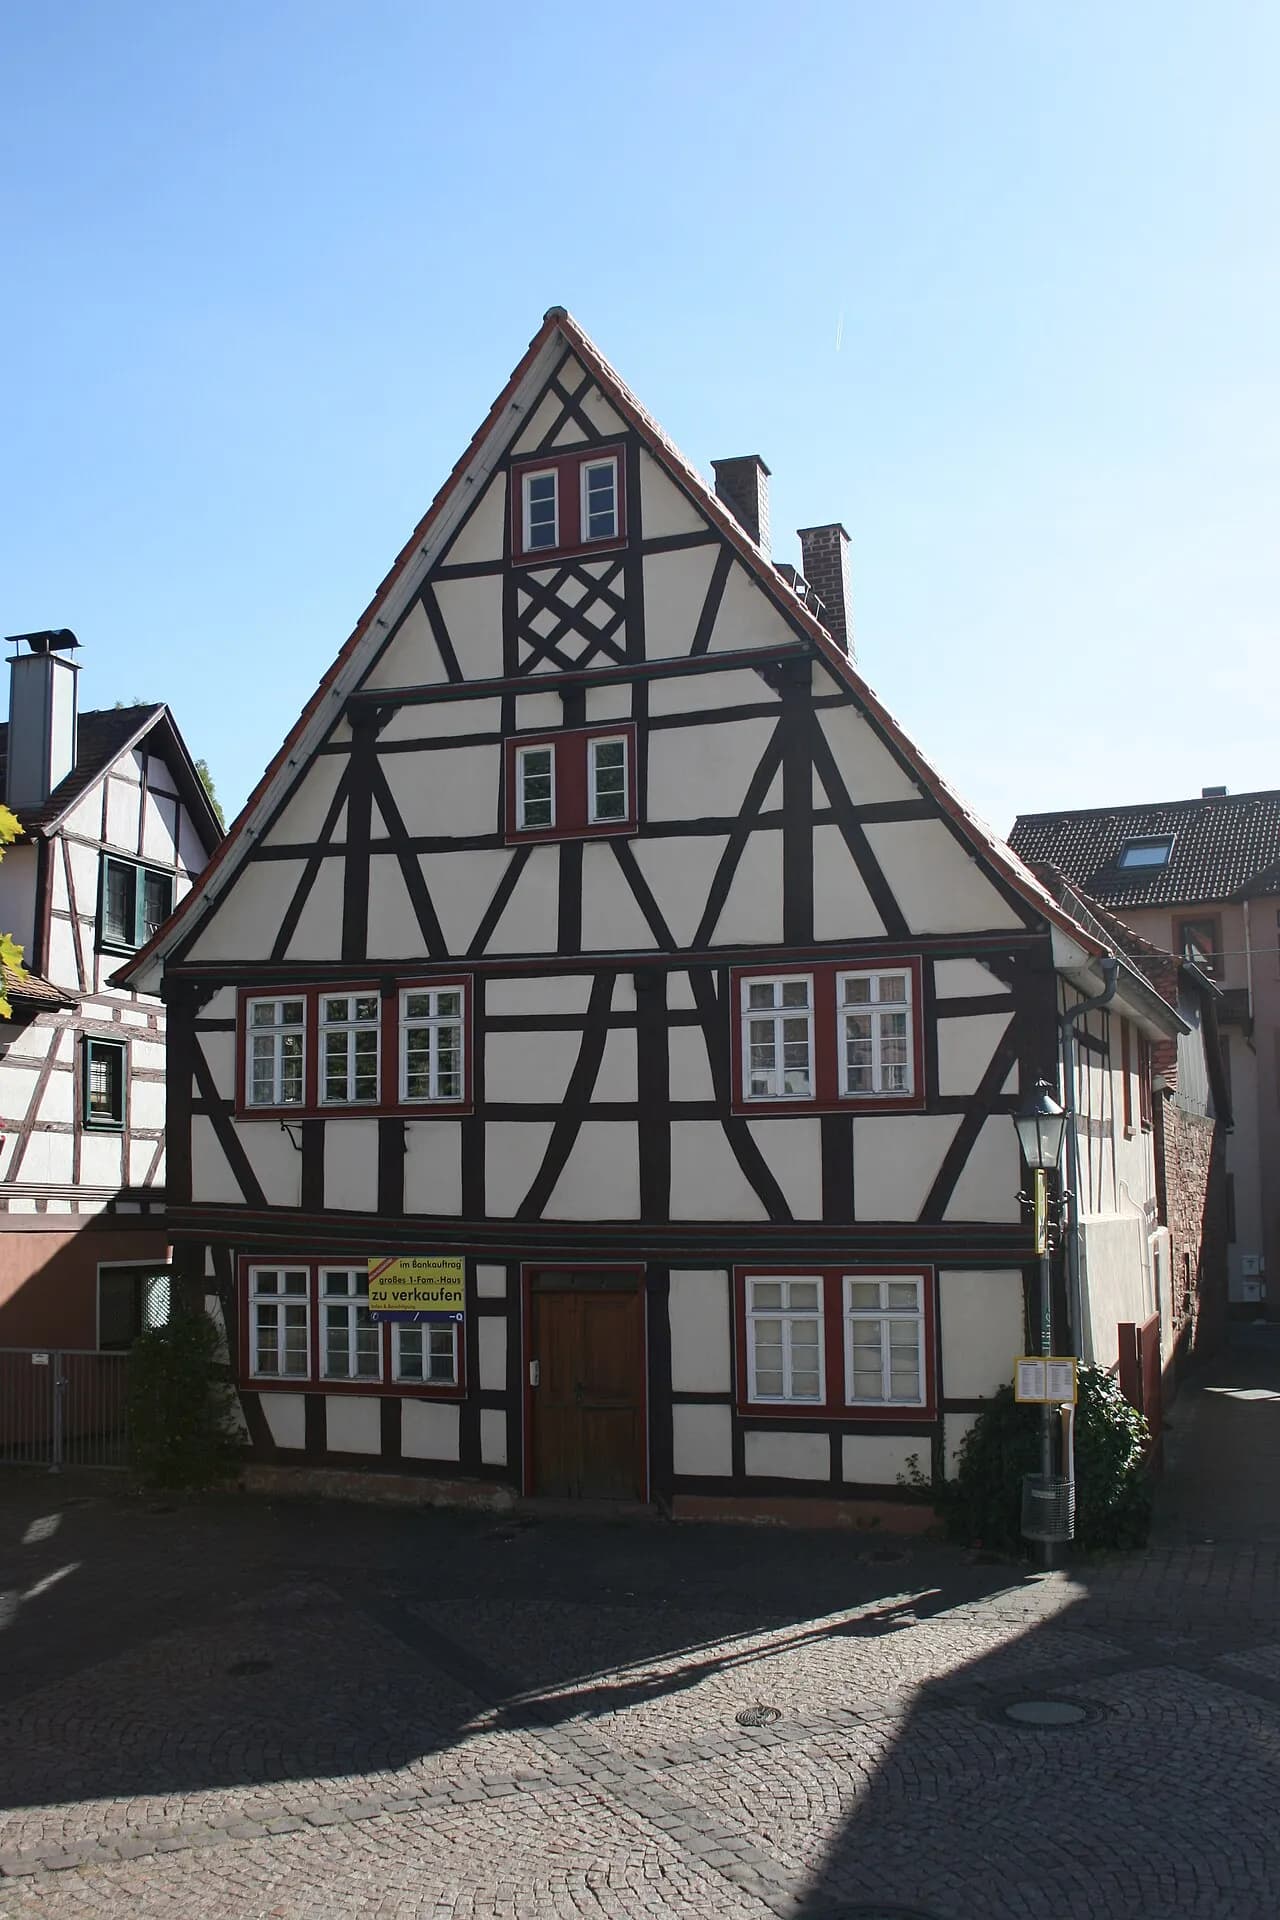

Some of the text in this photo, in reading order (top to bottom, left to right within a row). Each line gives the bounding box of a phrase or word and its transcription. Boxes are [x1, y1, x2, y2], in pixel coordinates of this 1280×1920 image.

[400, 1260, 461, 1270] im Bankauftrag
[379, 1276, 406, 1285] großes
[372, 1287, 462, 1301] zu verkaufen
